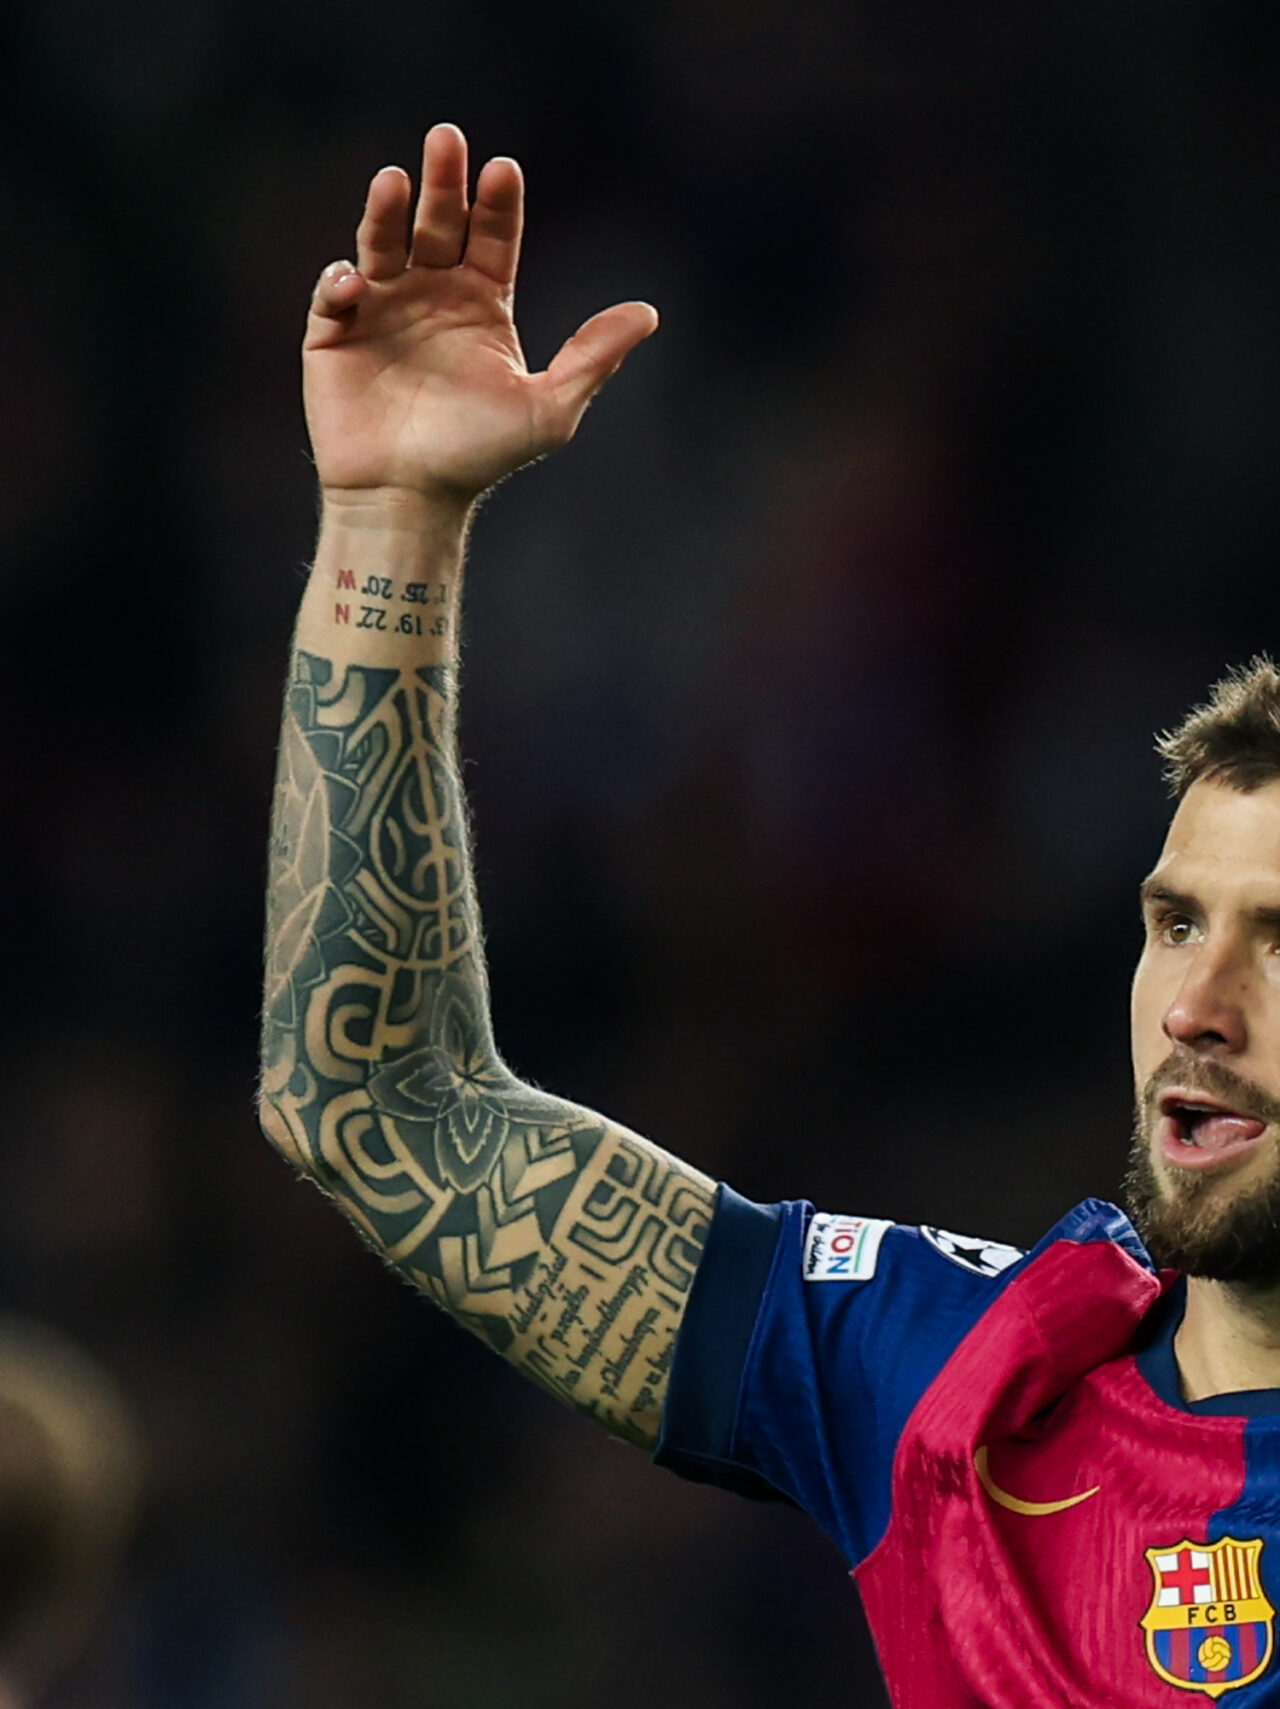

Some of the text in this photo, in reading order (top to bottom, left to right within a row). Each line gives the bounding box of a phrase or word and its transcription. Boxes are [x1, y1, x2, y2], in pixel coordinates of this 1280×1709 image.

[336, 569, 356, 590] W
[335, 604, 350, 624] N
[1188, 1604, 1237, 1625] FCB
